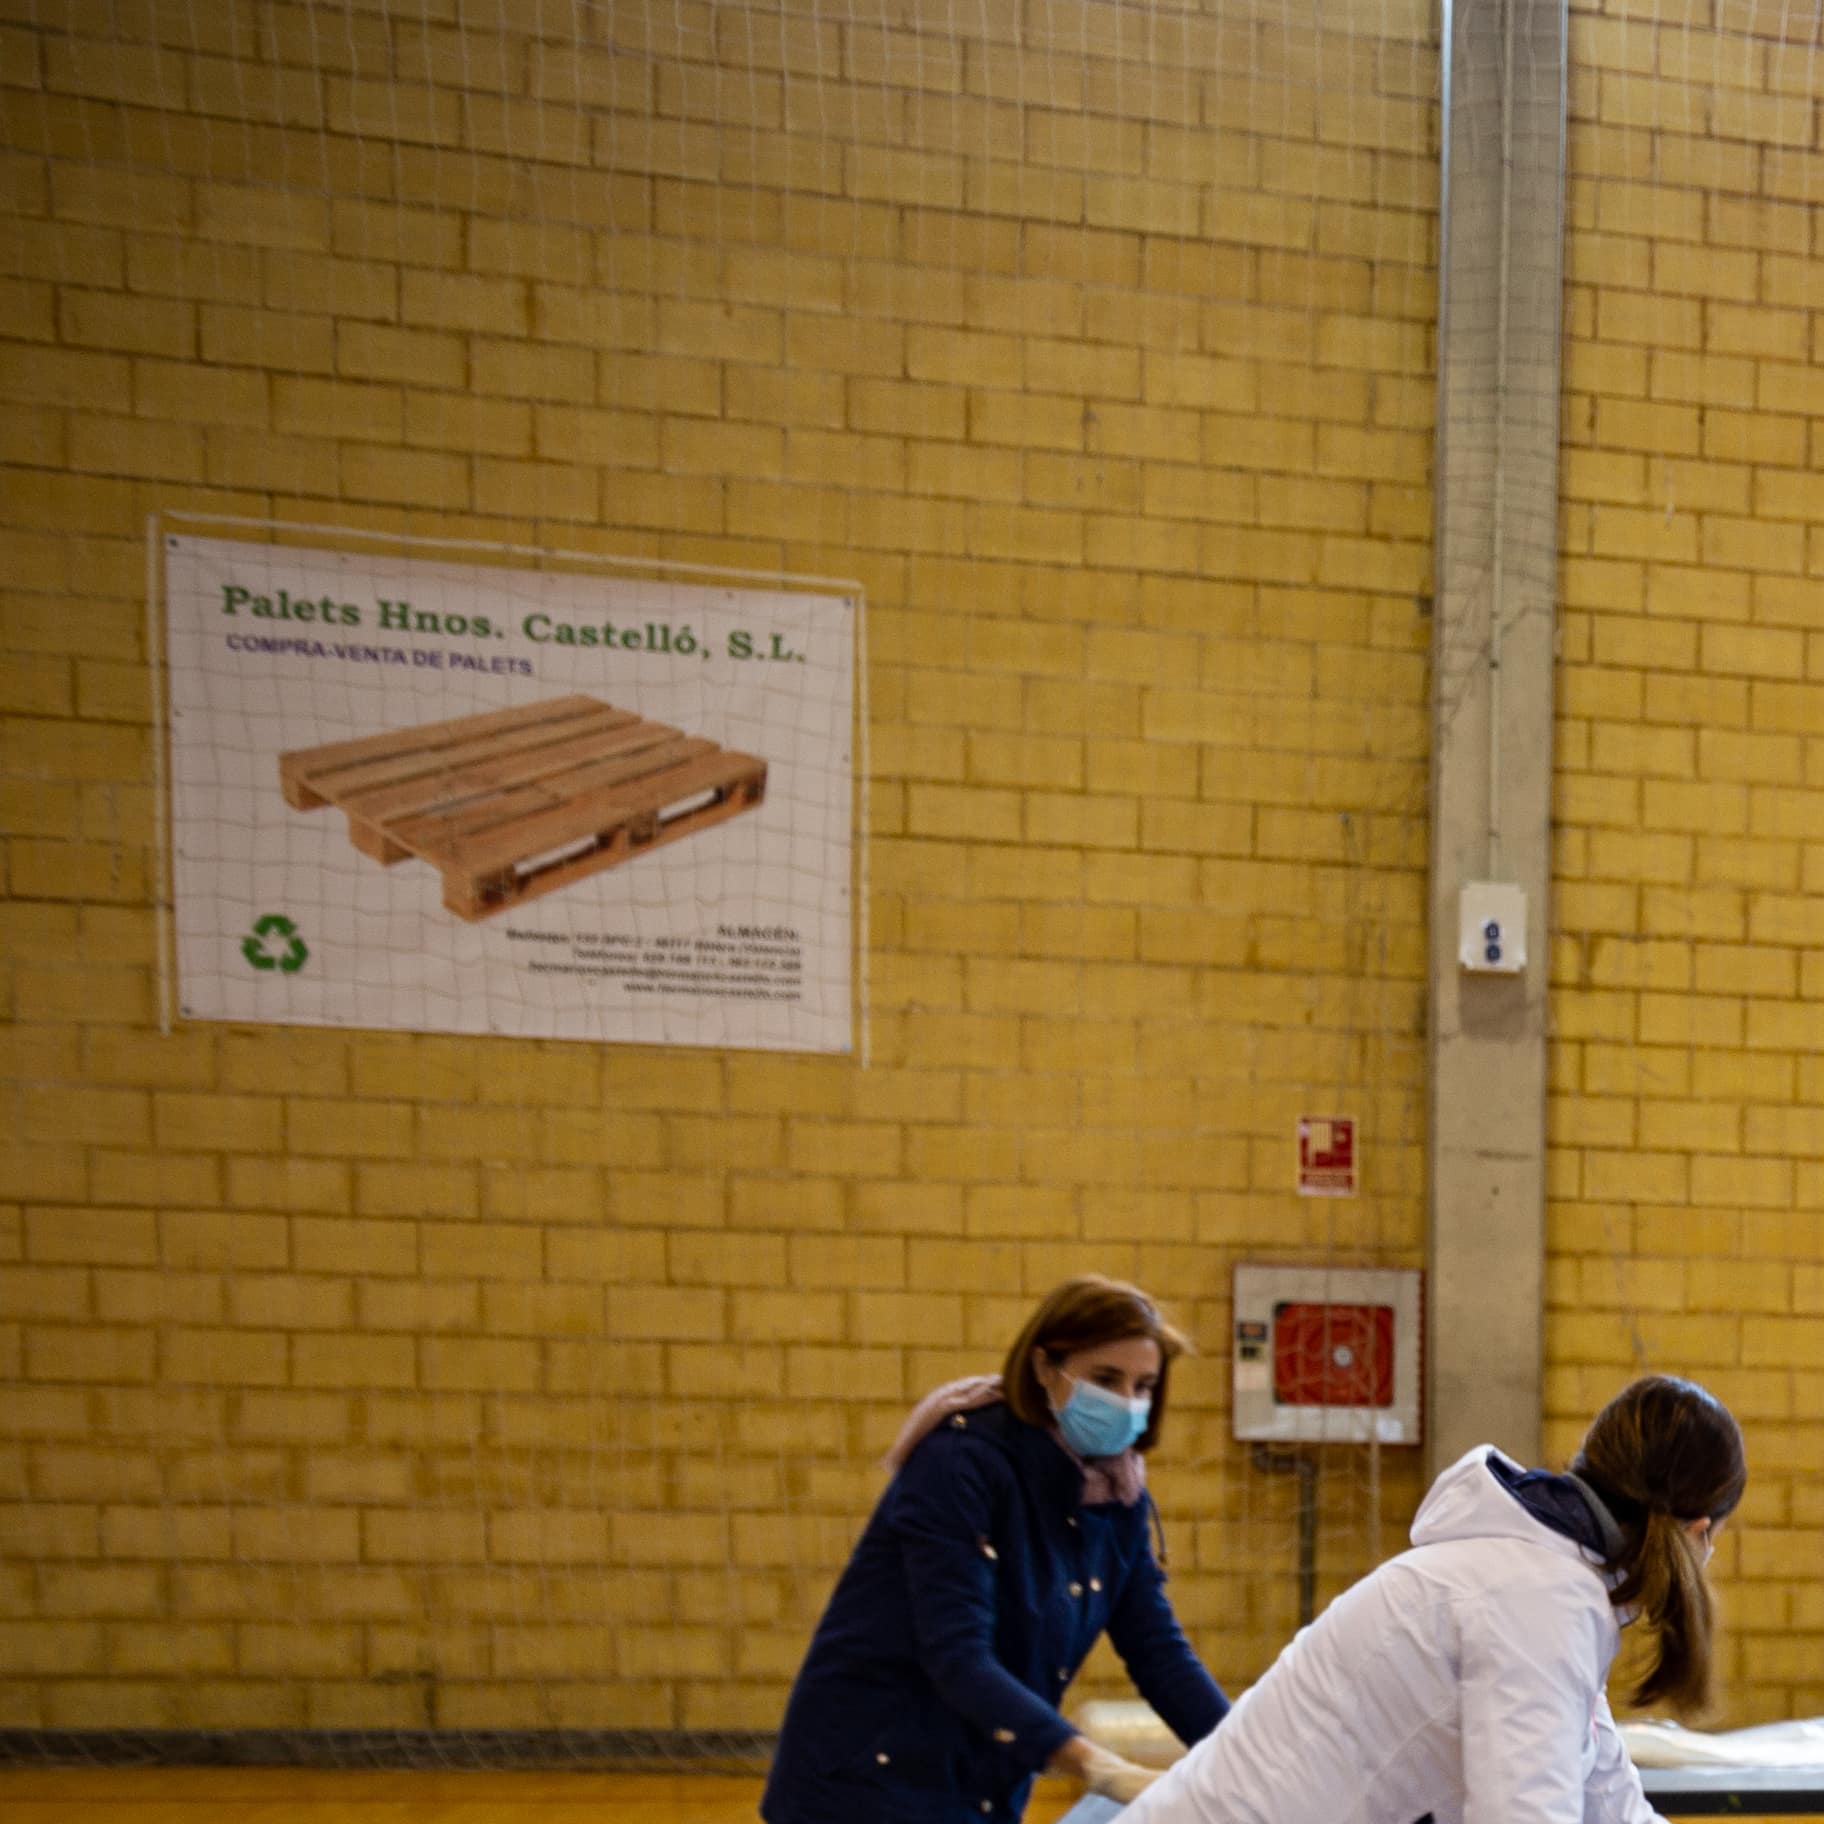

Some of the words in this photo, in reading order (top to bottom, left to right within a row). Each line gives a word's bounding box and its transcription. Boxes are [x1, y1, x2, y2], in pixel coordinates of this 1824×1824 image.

[221, 585, 361, 625] Palets
[377, 599, 503, 638] Hnos.
[522, 613, 711, 659] Castelló,
[727, 629, 805, 663] S.L.
[225, 633, 407, 666] COMPRA-VENTA
[413, 650, 444, 668] DE
[450, 653, 533, 676] PALETS
